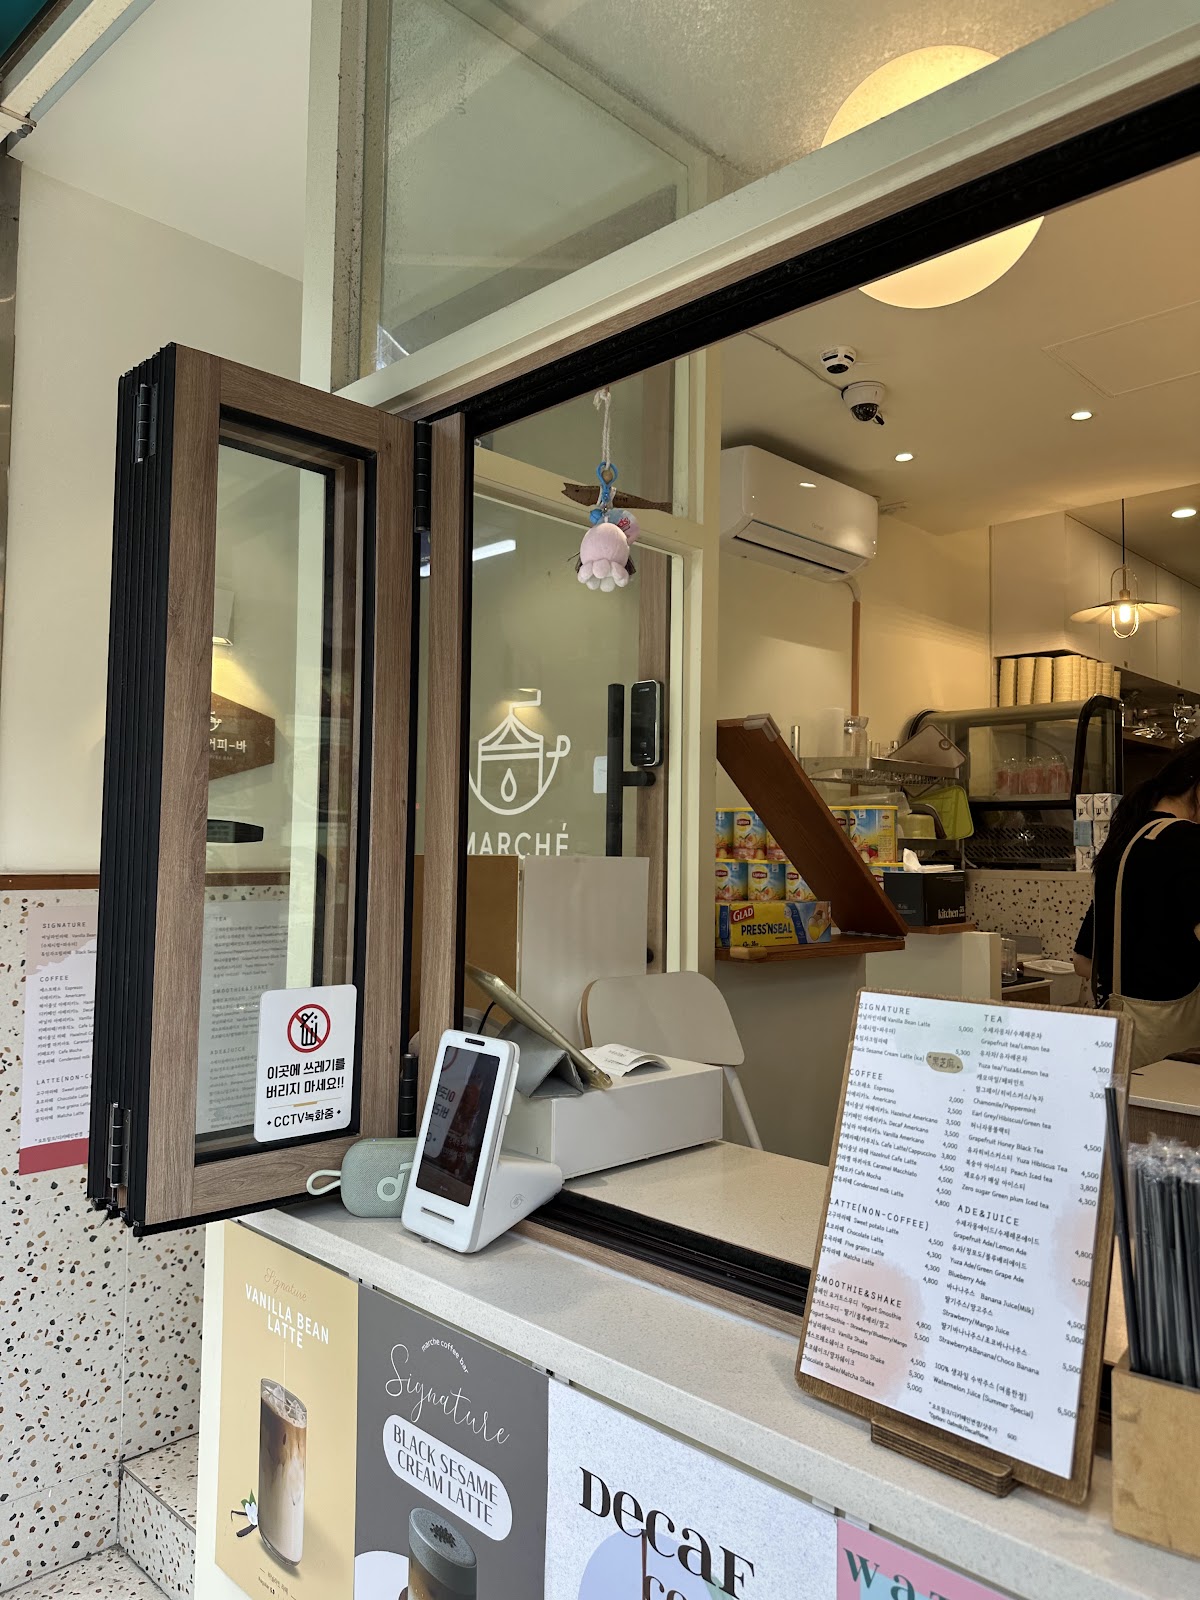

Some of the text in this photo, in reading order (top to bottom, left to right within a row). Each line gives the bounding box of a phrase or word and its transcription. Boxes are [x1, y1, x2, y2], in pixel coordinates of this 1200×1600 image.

[733, 907, 754, 921] GLAD
[938, 909, 958, 919] kitchen
[859, 1002, 910, 1015] SIGNATURE
[984, 1014, 1002, 1023] TEA
[958, 1025, 973, 1033] 5,000
[955, 1048, 970, 1056] 5,300
[980, 1038, 1008, 1047] Grapefruit
[1009, 1041, 1039, 1051] tea/Lemon
[1094, 1040, 1112, 1048] 4,500
[268, 1058, 345, 1079] 이곳에 쓰레기를
[848, 1068, 882, 1080] COFFEE
[991, 1064, 1038, 1076] tea/Yuza&Lemon
[1091, 1066, 1110, 1074] 4,300
[266, 1076, 344, 1098] 버리지 마세요!!
[948, 1096, 964, 1104] 2,000
[973, 1097, 1036, 1113] Chamomile/Peppermint
[274, 1108, 334, 1127] CCTV녹화중
[947, 1107, 962, 1115] 2,500
[971, 1109, 982, 1117] Earl
[945, 1118, 961, 1127] 3,500
[944, 1129, 959, 1138] 3,500
[942, 1141, 958, 1149] 4,000
[968, 1134, 1044, 1154] Grapefruit Honey Black Tea
[1083, 1143, 1101, 1152] 4,500
[940, 1152, 956, 1161] 3,800
[903, 1157, 955, 1173] Latte 4,500
[1016, 1156, 1030, 1165] Yuza
[1031, 1159, 1055, 1170] Hibiscus
[1057, 1164, 1068, 1172] Tea
[1080, 1170, 1099, 1179] 4,500
[937, 1176, 953, 1184] 4,500
[1010, 1168, 1027, 1177] Peach
[1028, 1172, 1042, 1180] Iced
[1043, 1175, 1053, 1183] tea
[1079, 1183, 1098, 1193] 3,800
[936, 1187, 951, 1196] 4,500
[961, 1183, 1049, 1209] Zero sugar Green plum Iced tea
[934, 1199, 950, 1207] 4,800
[1078, 1197, 1096, 1207] 4,300
[828, 1195, 928, 1231] LATTE(NON-COFFEE)
[957, 1204, 1019, 1226] ADE&JUICE
[885, 1226, 944, 1247] Latte 4,500
[953, 1231, 1027, 1256] Grapefruit Ade/Lemon Ade
[870, 1235, 942, 1260] Latte 4,300
[1074, 1249, 1093, 1261] 4,800
[871, 1247, 940, 1273] Latte 4,300
[861, 1257, 938, 1285] Latte 4,800
[947, 1269, 986, 1286] Blueberry Ade
[950, 1257, 1024, 1283] Yuza Ade/Green Grape Ade
[264, 1267, 307, 1302] Signature
[815, 1273, 901, 1308] SMOOTHIE&SHAKE
[1071, 1277, 1091, 1289] 4,500
[246, 1283, 329, 1344] VANILLA BEAN
[980, 1292, 1002, 1305] Banana
[1066, 1319, 1086, 1332] 4,500
[915, 1320, 931, 1330] 4,800
[942, 1308, 1009, 1336] Strawberry/Mango Juice
[268, 1314, 303, 1348] LATTE
[913, 1332, 929, 1343] 5,500
[1065, 1333, 1085, 1347] 5,000
[441, 1339, 460, 1359] coffee
[459, 1357, 469, 1373] bar
[854, 1335, 926, 1368] Shake 4,500
[938, 1335, 1039, 1375] Strawberry&Banana/Choco Banana
[869, 1353, 924, 1381] Shake 5,300
[1062, 1362, 1082, 1376] 5,500
[859, 1375, 875, 1387] Shake
[906, 1382, 922, 1393] 5,000
[385, 1344, 510, 1444] Signature
[933, 1376, 1033, 1419] Watermelon Juice (Summer Special)
[935, 1362, 949, 1373] 100%
[1057, 1406, 1077, 1421] 6,500
[393, 1424, 498, 1506] BLACK SESAME
[397, 1450, 493, 1527] CREAM LATTE
